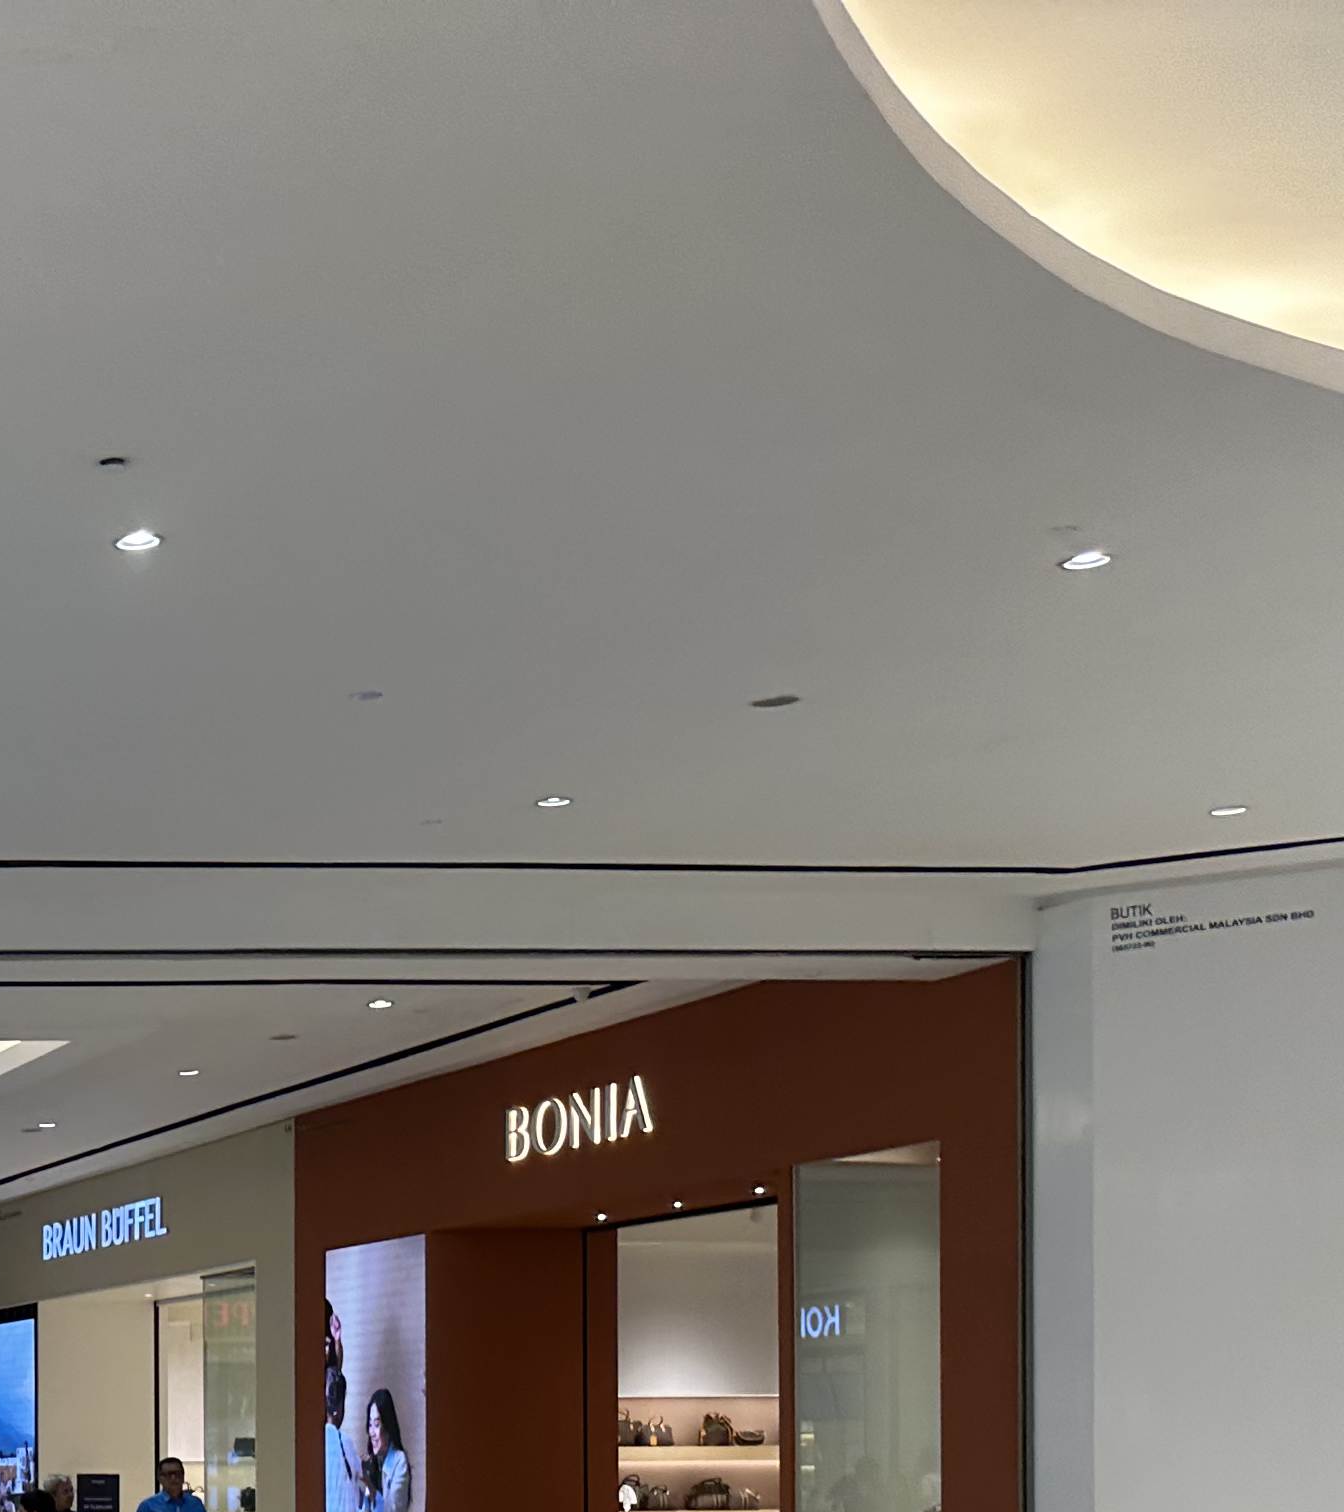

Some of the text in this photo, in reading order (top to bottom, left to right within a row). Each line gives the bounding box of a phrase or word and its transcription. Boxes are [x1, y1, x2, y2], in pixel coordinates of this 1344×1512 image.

[1110, 904, 1153, 920] BUTIK
[1135, 924, 1207, 939] COMMERCIAL
[1208, 916, 1263, 929] MALAYSIA
[1264, 913, 1289, 923] SDN
[1290, 909, 1315, 920] BHD
[505, 1074, 654, 1162] BONIA
[42, 1212, 97, 1261] BRAUN
